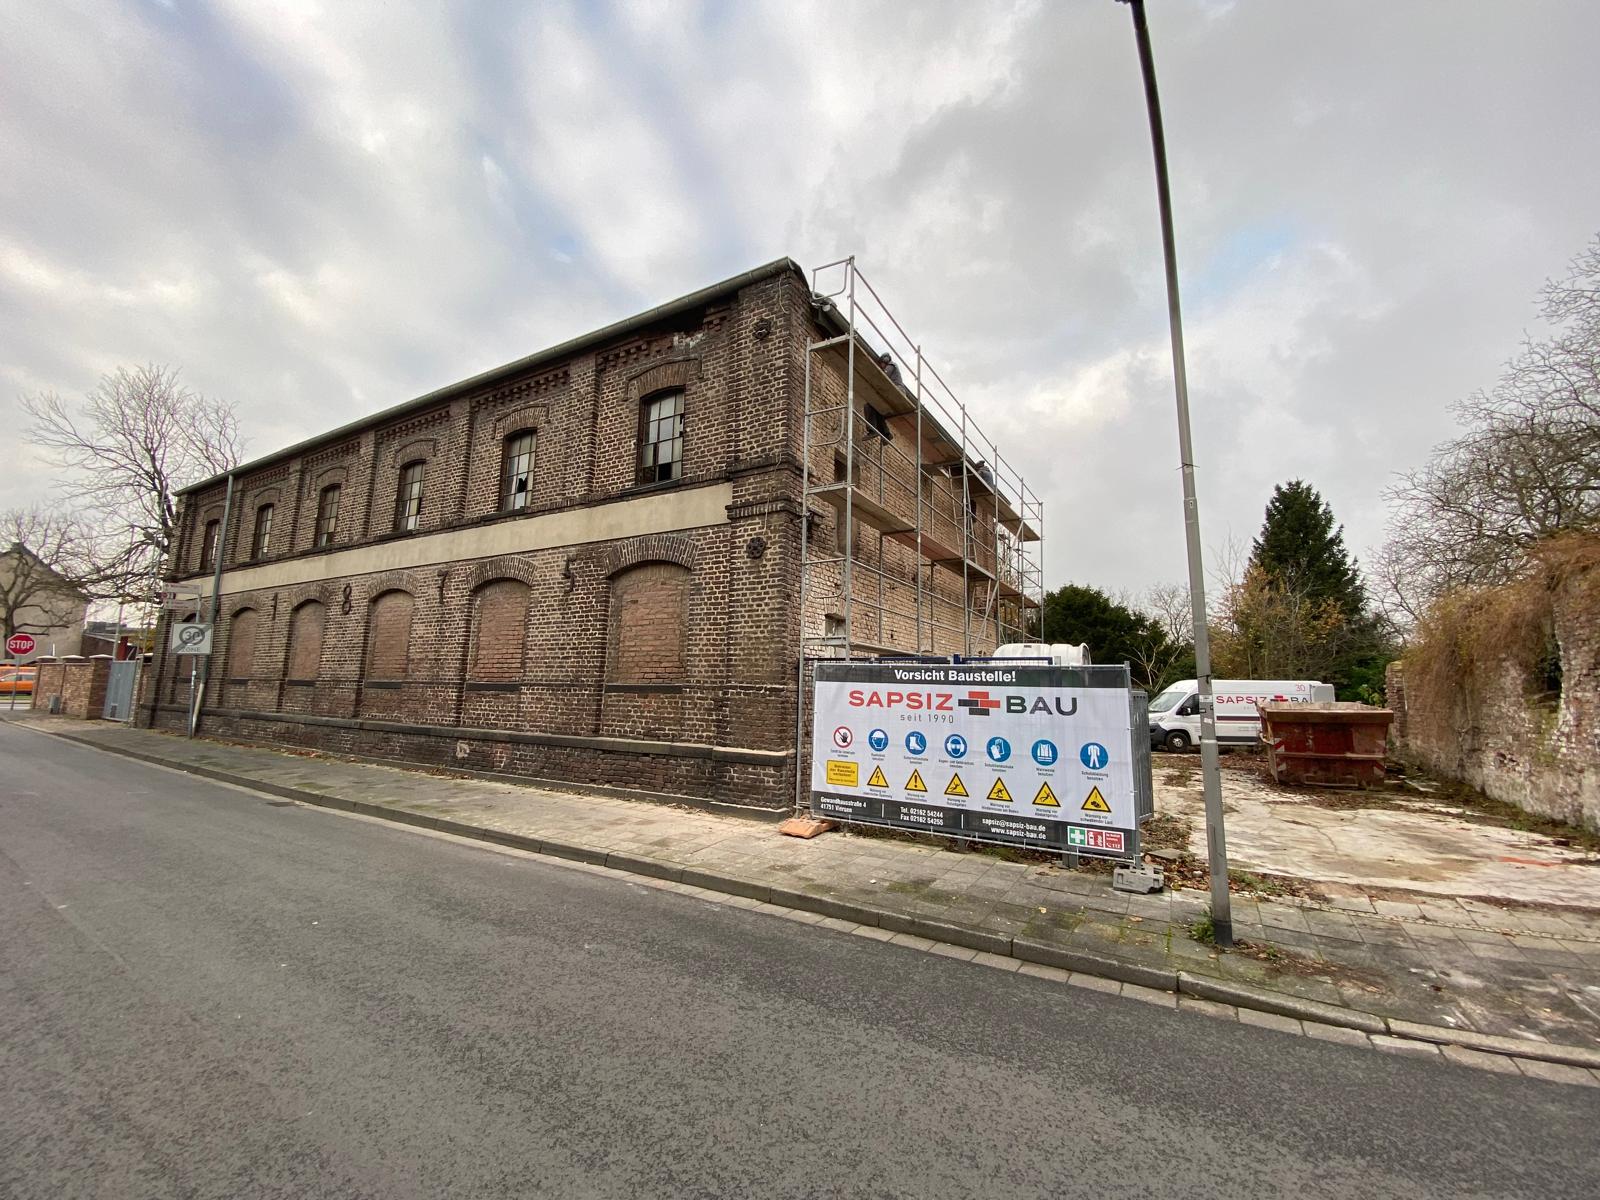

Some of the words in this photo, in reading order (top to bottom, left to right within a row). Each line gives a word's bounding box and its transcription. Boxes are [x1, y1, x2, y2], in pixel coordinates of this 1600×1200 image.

[9, 640, 34, 650] STOP
[895, 669, 945, 681] Vorsicht
[948, 670, 1016, 683] Baustelle!
[1295, 684, 1306, 692] 30
[848, 690, 954, 711] SAPSIZ
[1006, 695, 1078, 716] BAU
[900, 713, 923, 722] seit
[928, 714, 955, 724] 1990
[820, 796, 862, 808] Gewandhausstraße
[834, 804, 853, 813] Viersen
[900, 806, 909, 814] Tel.
[909, 807, 927, 816] 02162
[926, 809, 944, 818] 54244
[900, 813, 909, 821] Fax
[909, 815, 927, 824] 02162
[982, 818, 1046, 832] sapsiz@sapsiz-bau.de
[990, 827, 1047, 840] www.sapsiz-bau.de
